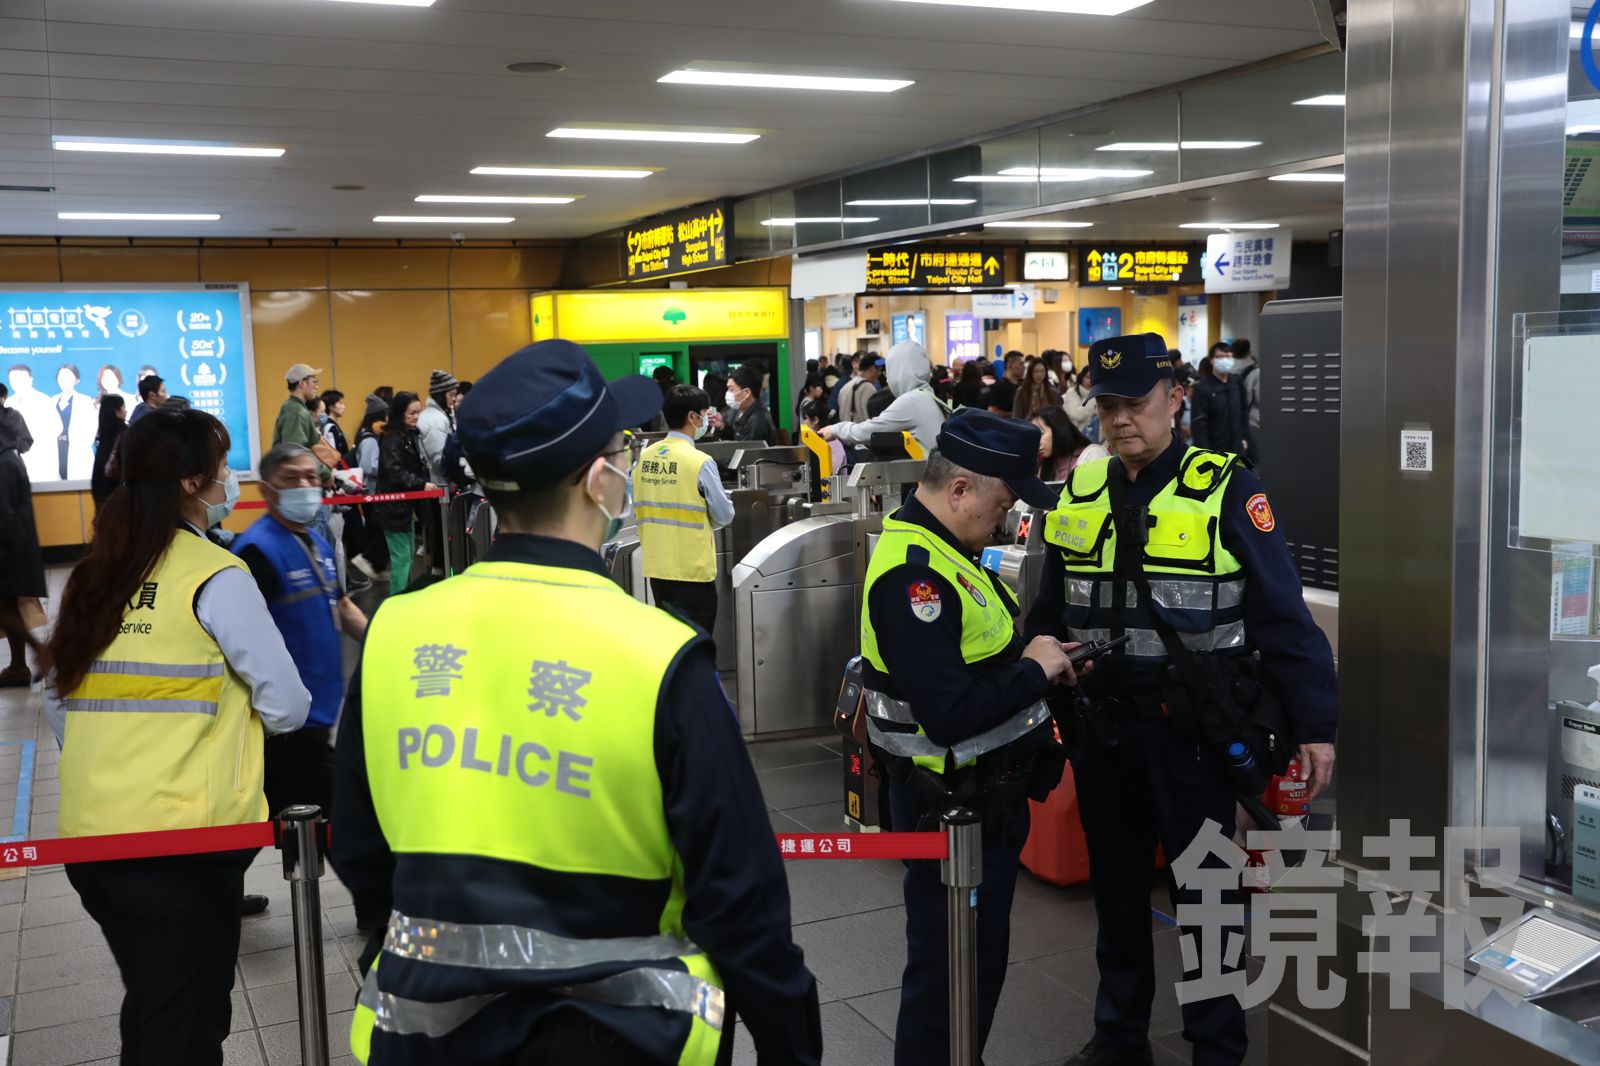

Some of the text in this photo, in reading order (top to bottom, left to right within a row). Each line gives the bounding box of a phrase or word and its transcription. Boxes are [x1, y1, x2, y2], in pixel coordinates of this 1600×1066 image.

[707, 213, 715, 247] 1
[634, 232, 642, 263] 2
[1234, 237, 1273, 253] 市民廣場
[1118, 252, 1134, 278] 2
[1233, 253, 1273, 268] 跨年晚會
[945, 267, 983, 276] Route For
[888, 276, 909, 285] Store
[926, 275, 983, 285] Taipei City Hall
[641, 460, 678, 475] 服務人員
[1054, 530, 1086, 547] POLICE
[118, 618, 152, 634] Service
[410, 643, 592, 722] 警察
[398, 723, 594, 799] POLICE
[781, 838, 851, 853] 捷運公司
[3, 846, 38, 862] 公司
